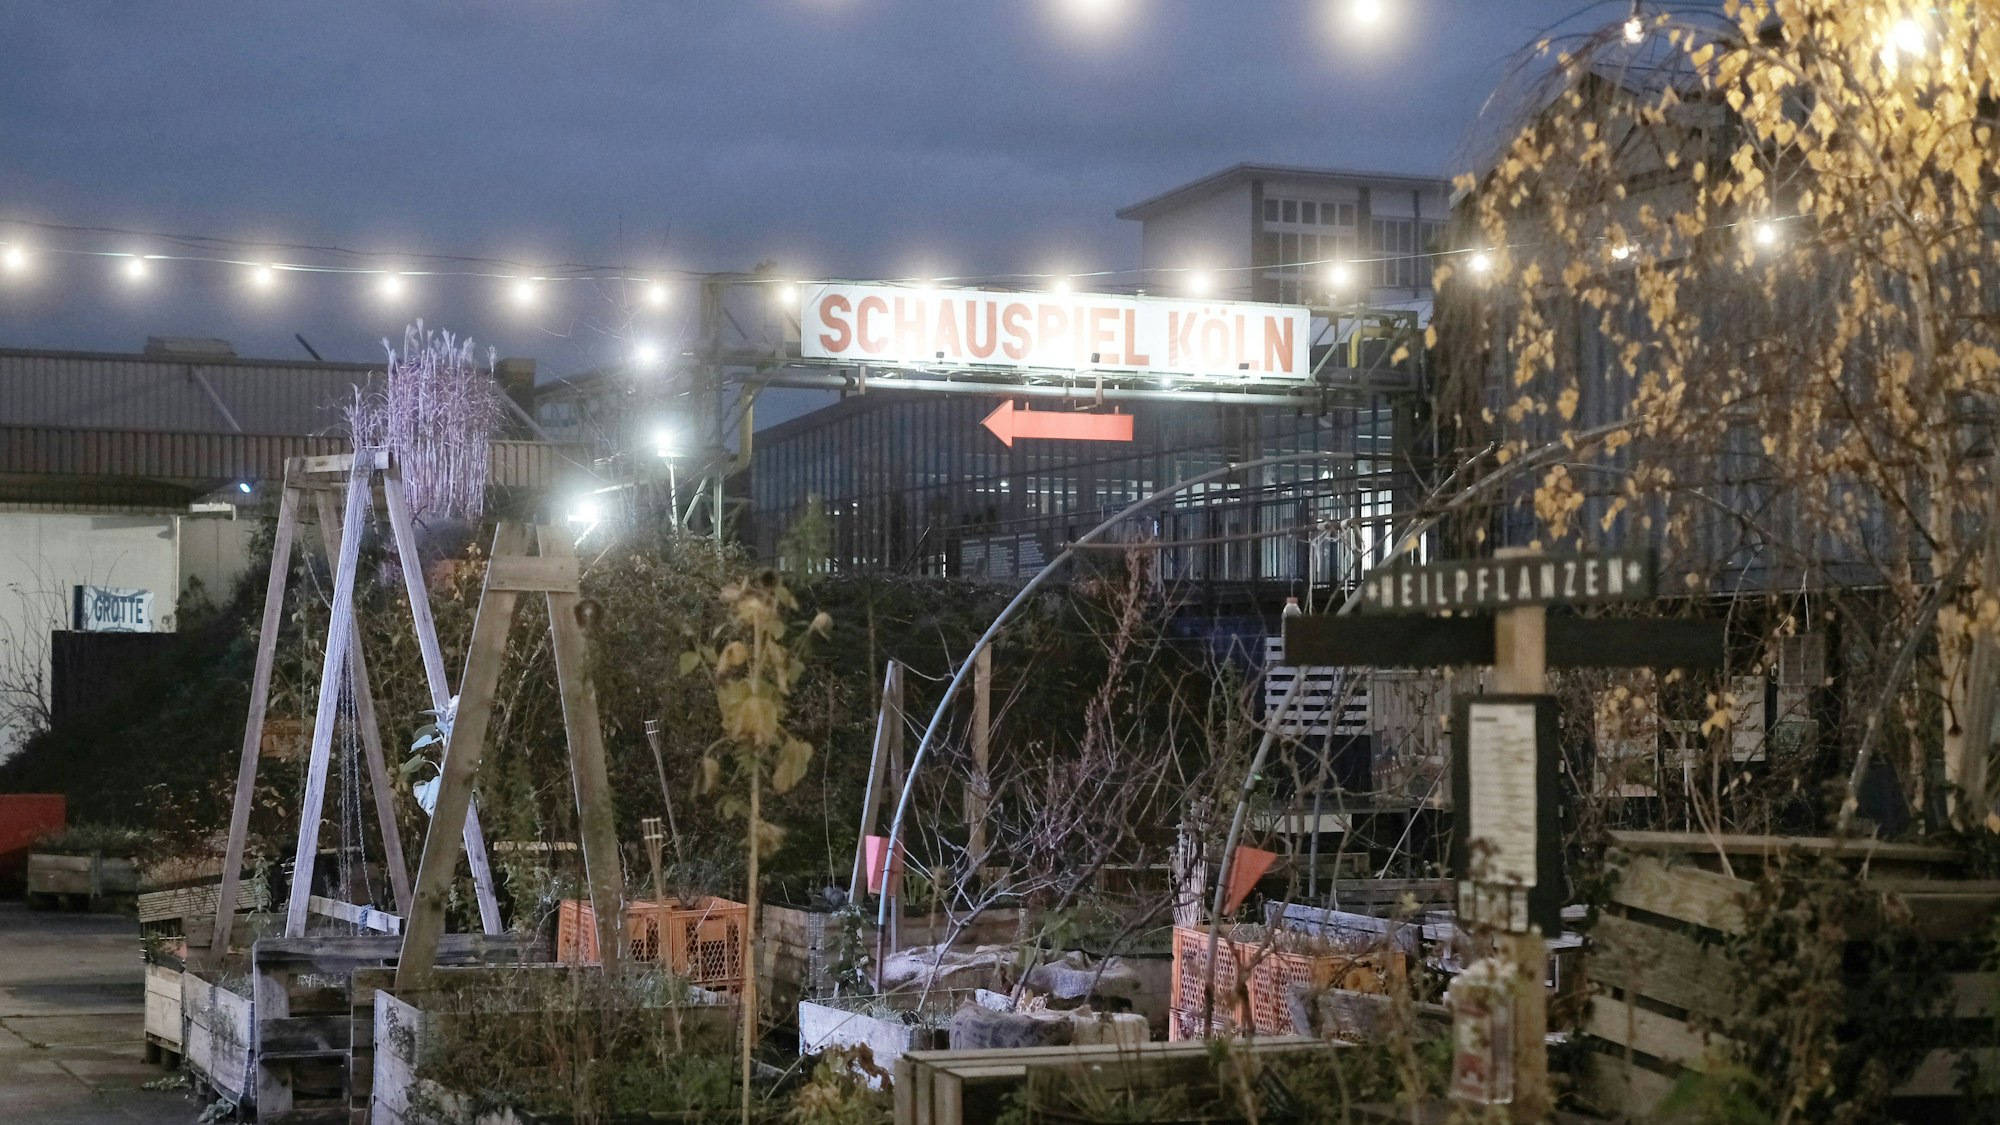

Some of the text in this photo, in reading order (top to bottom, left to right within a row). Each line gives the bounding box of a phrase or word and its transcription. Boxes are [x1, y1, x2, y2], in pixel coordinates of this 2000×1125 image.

[819, 294, 1294, 373] SCHAUSPIEL KÖLN
[95, 596, 144, 624] GROTTE
